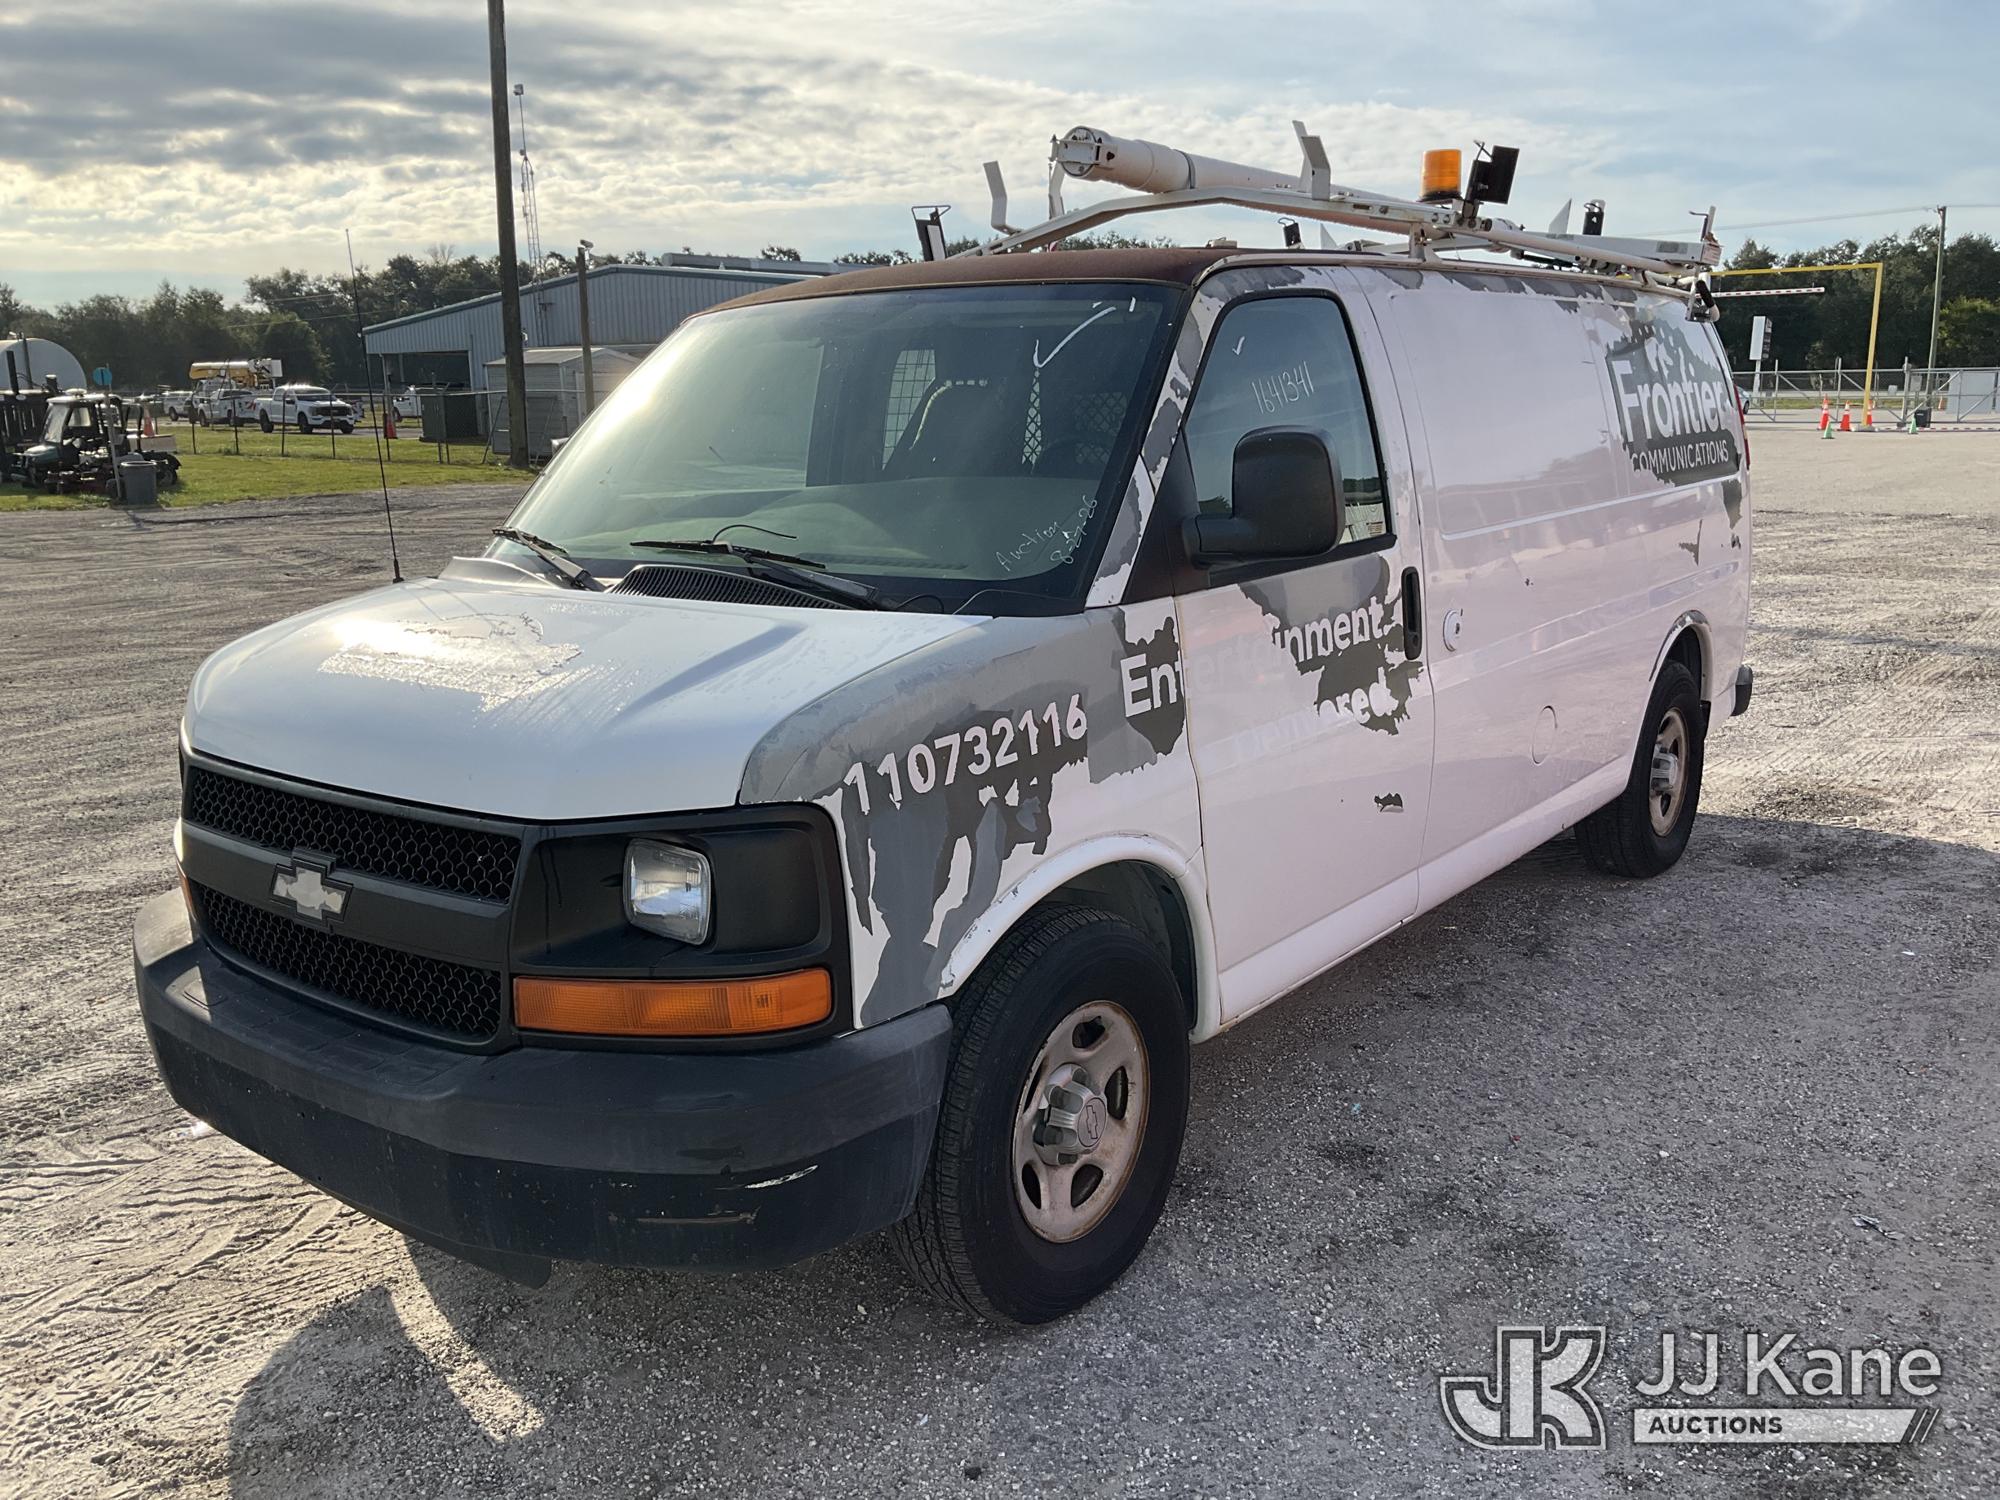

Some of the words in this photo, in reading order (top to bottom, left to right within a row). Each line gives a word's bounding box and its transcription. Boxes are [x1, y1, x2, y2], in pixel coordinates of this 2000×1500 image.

[1611, 360, 1726, 442] Frontier
[1630, 439, 1729, 475] COMMUNICATIONS
[843, 693, 1087, 816] 110732116
